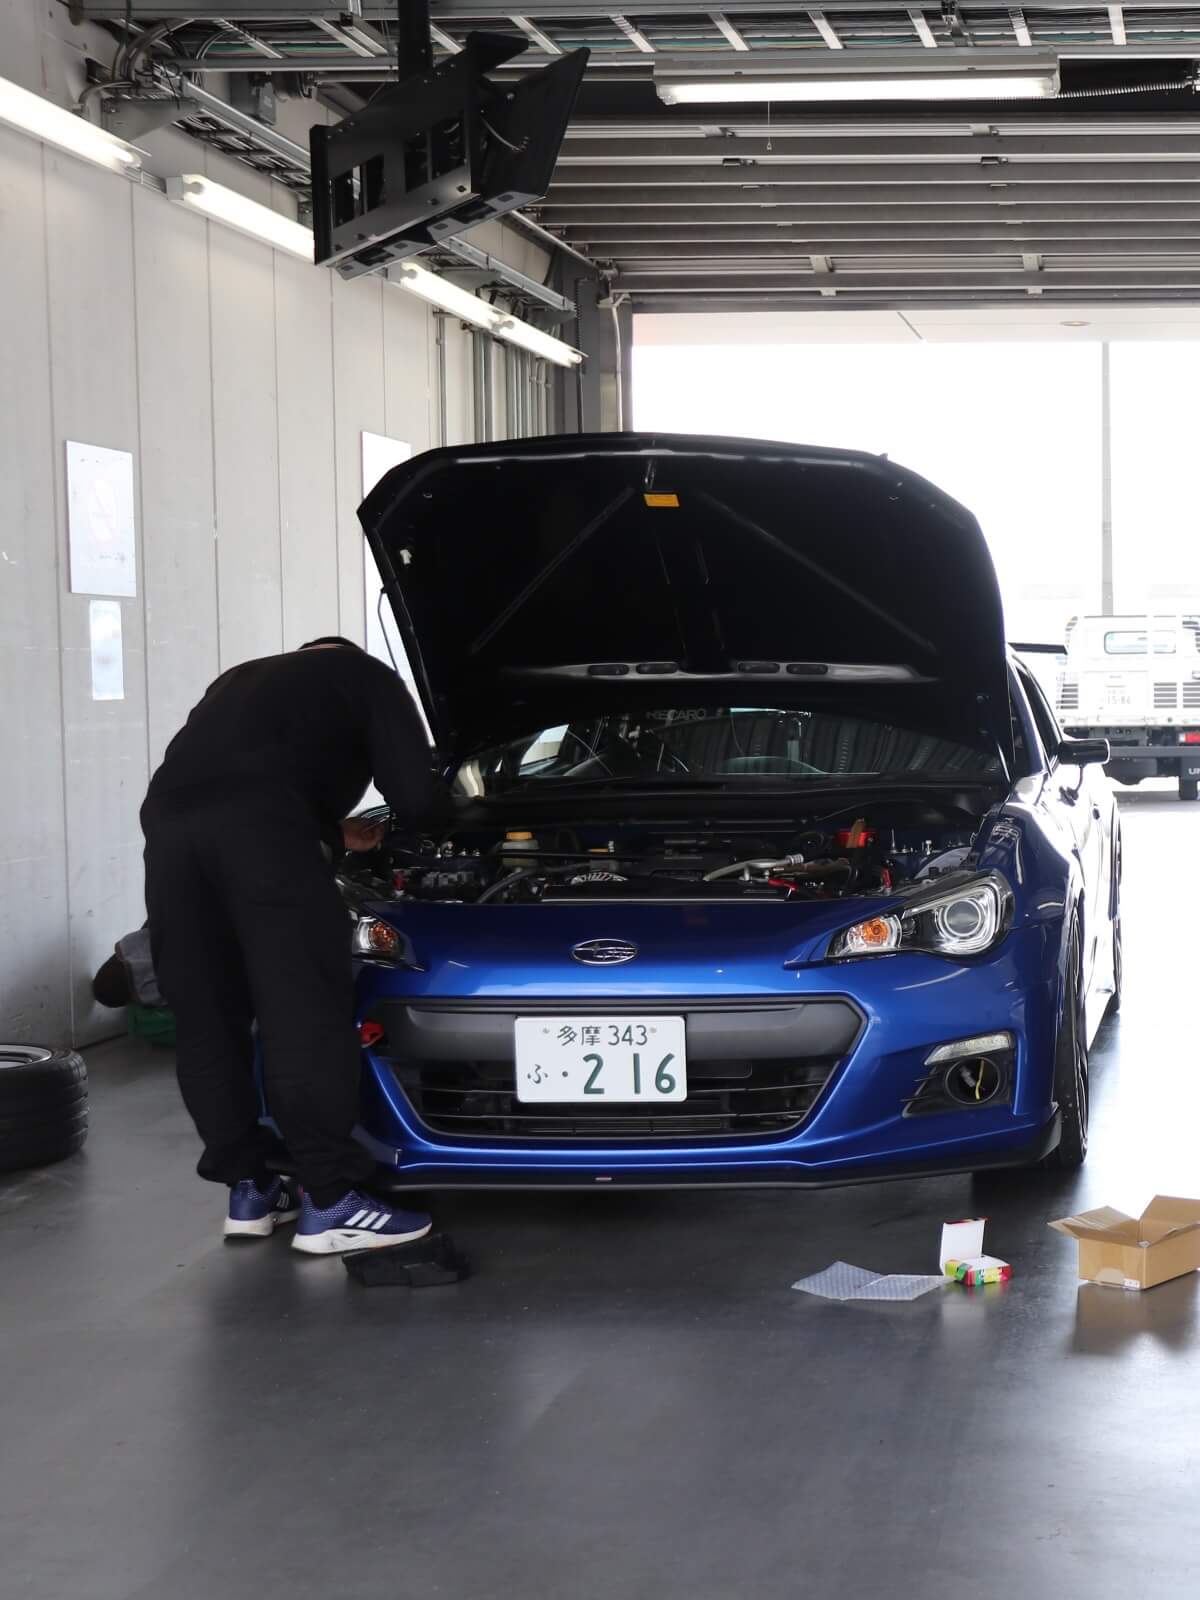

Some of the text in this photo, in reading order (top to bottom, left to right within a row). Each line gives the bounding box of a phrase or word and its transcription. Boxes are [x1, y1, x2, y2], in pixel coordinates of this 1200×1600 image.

[557, 1025, 648, 1046] 多摩 343
[527, 1064, 548, 1084] ふ
